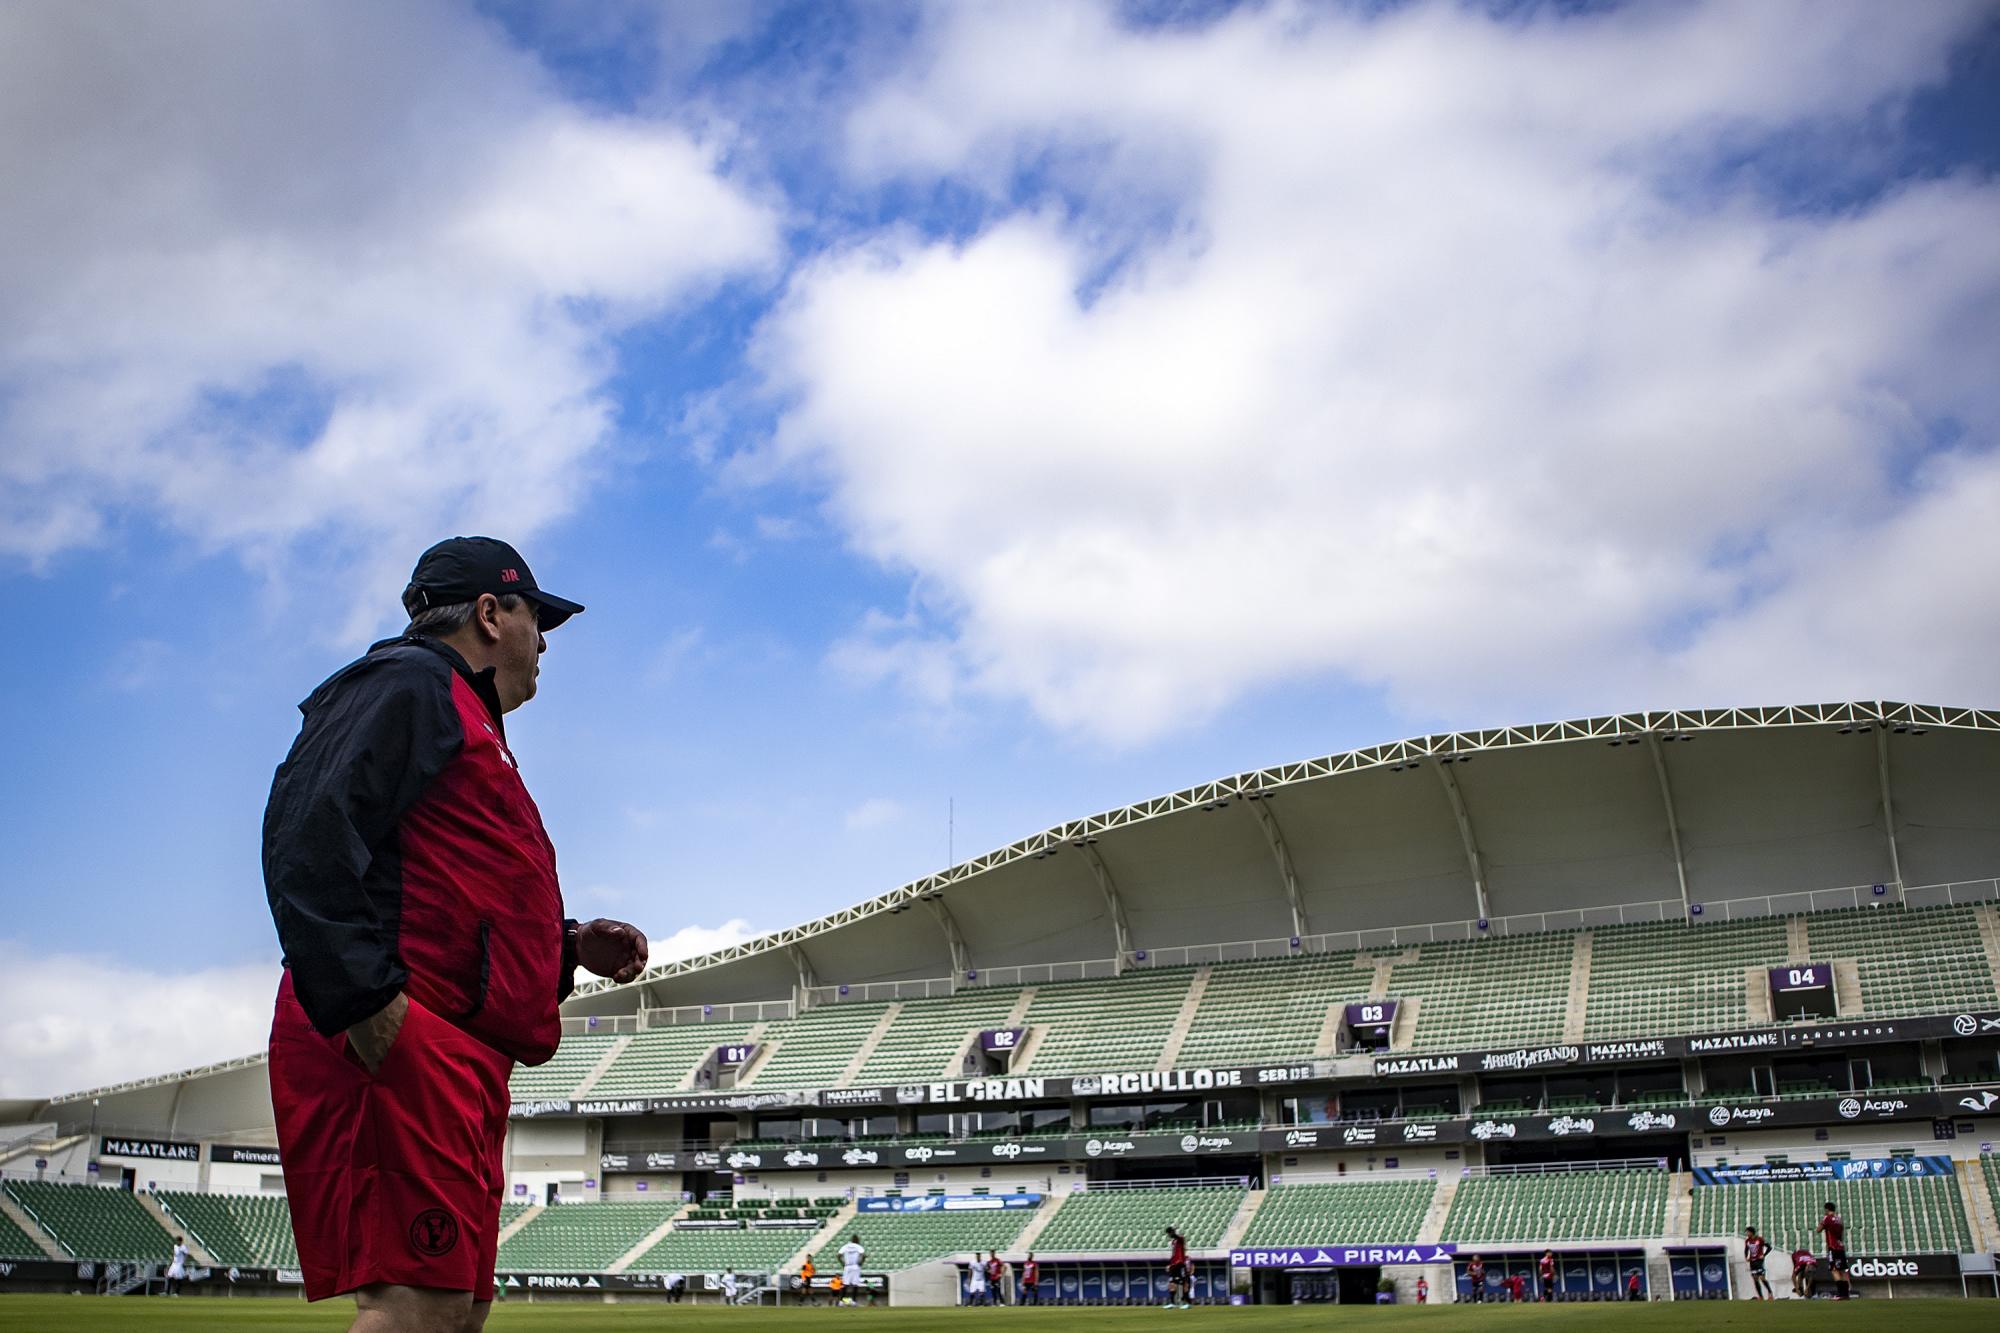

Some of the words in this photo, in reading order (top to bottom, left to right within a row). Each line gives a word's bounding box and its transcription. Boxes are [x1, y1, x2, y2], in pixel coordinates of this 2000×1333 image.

[1789, 968, 1815, 986] 04
[1361, 1006, 1384, 1022] 03
[994, 1032, 1014, 1047] 02
[727, 1047, 746, 1062] 01
[929, 1083, 962, 1103] EL
[965, 1079, 1045, 1100] GRAN
[1216, 1070, 1242, 1087] DE
[1258, 1068, 1288, 1082] SER
[233, 1151, 280, 1163] Primera
[1231, 1251, 1306, 1265] PIRMA
[1344, 1249, 1422, 1263] PIRMA
[1850, 1258, 1919, 1277] debate
[527, 1276, 581, 1288] PIRMA
